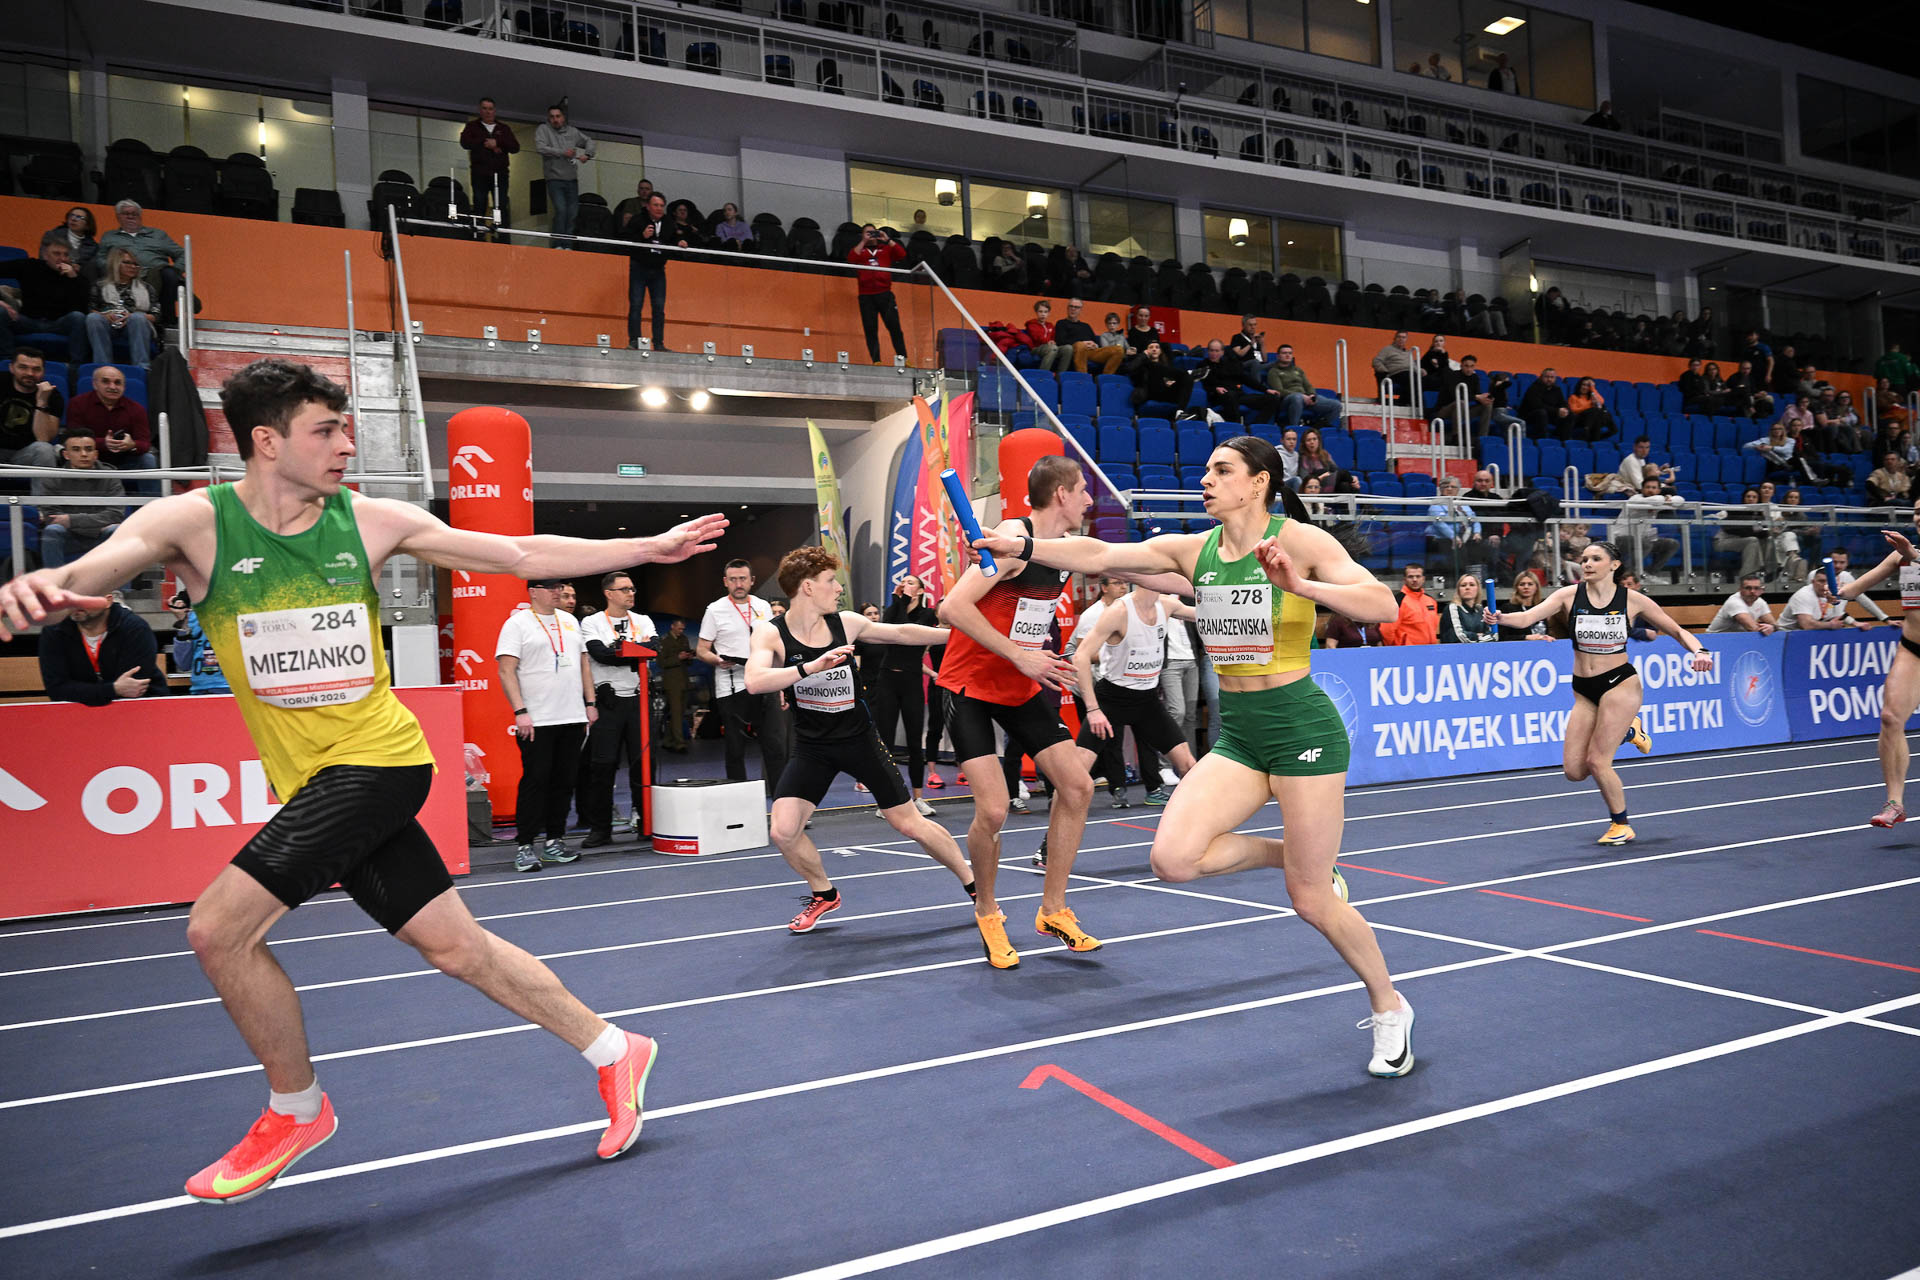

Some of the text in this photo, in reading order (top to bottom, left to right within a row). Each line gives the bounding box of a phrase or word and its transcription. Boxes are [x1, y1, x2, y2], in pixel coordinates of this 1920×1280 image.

[450, 484, 501, 501] ORLEN
[891, 510, 911, 587] AWY
[231, 557, 265, 575] 4F
[1198, 571, 1218, 585] 4F
[1231, 589, 1263, 605] 278
[311, 609, 357, 632] 284
[1197, 618, 1269, 636] GRANASZEWSKA
[1604, 616, 1621, 625] 317
[1577, 630, 1625, 640] BOROWSKA
[249, 643, 367, 677] MIEZIANKO
[1235, 653, 1256, 662] 2026
[1809, 640, 1897, 680] KUJAW
[825, 669, 848, 681] 320
[281, 692, 318, 706] TORUŃ
[319, 690, 347, 703] 2026
[796, 685, 851, 698] CHOJNOWSKI
[1373, 713, 1505, 761] ZWIĄZEK
[1637, 698, 1724, 735] TLETYKI
[1297, 747, 1323, 763] 4F
[81, 761, 285, 836] ORL
